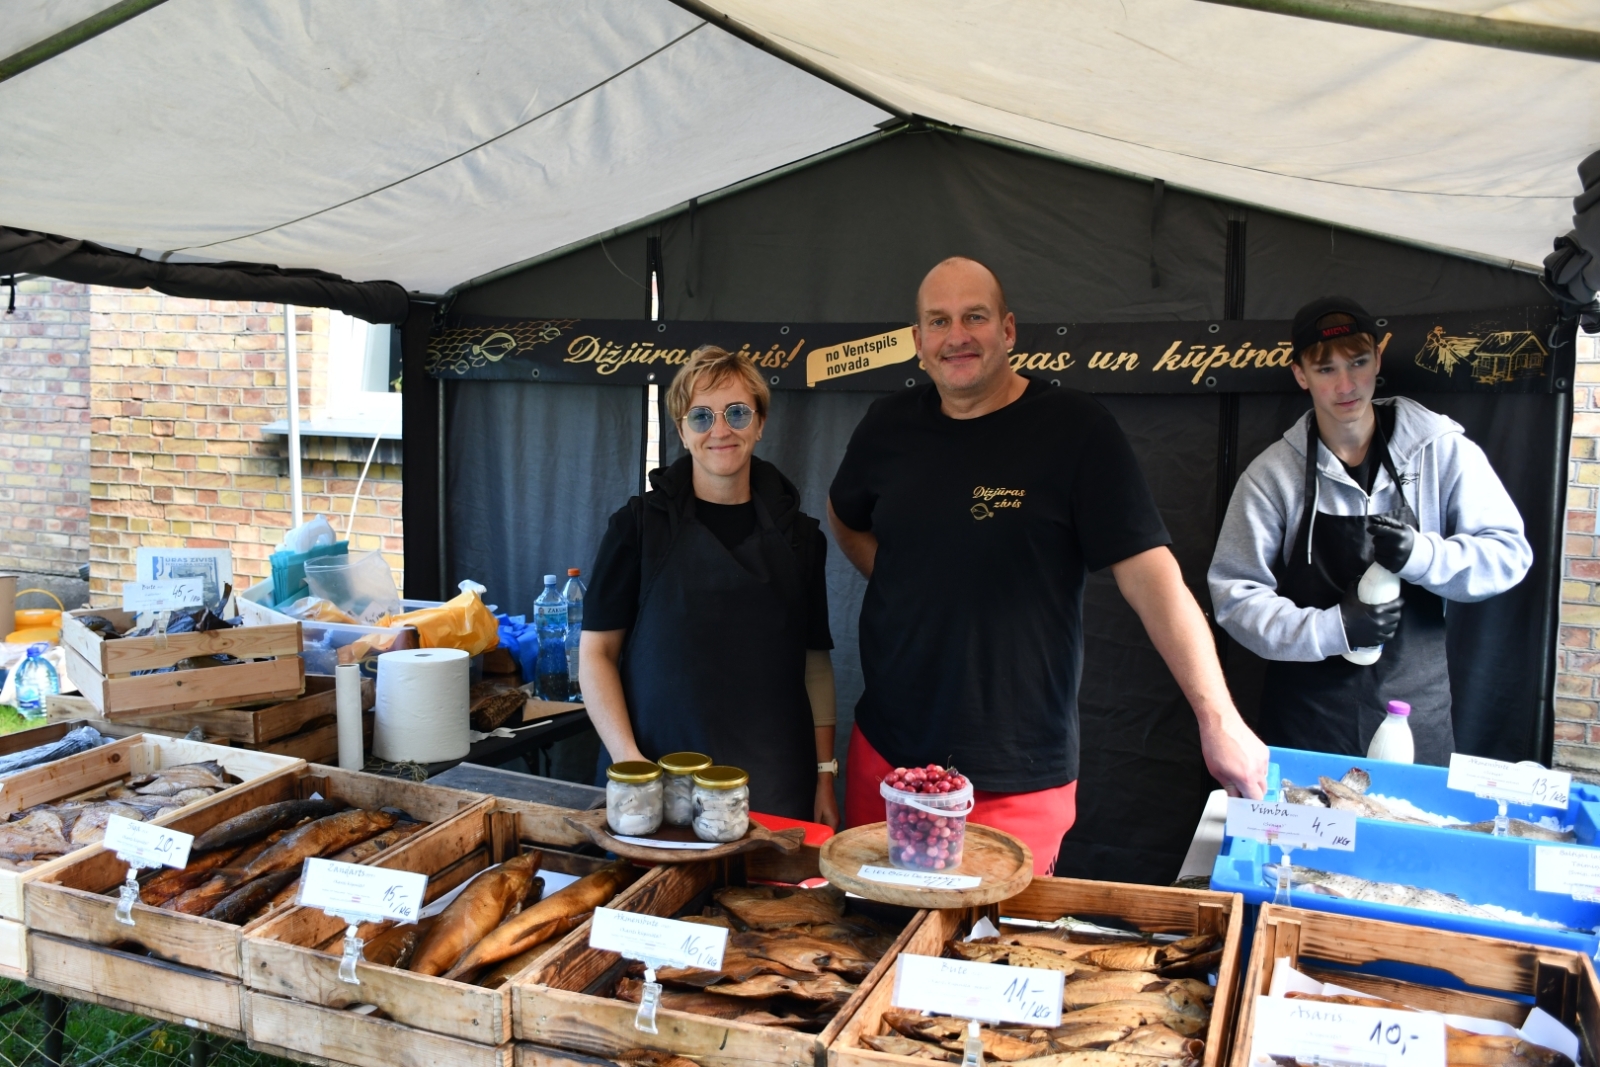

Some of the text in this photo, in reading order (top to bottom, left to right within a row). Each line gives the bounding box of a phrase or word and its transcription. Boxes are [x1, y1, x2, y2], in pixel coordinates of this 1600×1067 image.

[736, 339, 805, 369] ivis!
[825, 335, 898, 363] no Ventspils
[826, 356, 870, 377] novada
[1087, 350, 1140, 372] un
[972, 485, 1026, 501] Dižjūras
[993, 498, 1022, 508] zivis
[1250, 803, 1290, 817] Vimba
[940, 961, 968, 975] Bute
[1289, 1004, 1343, 1024] Asaris
